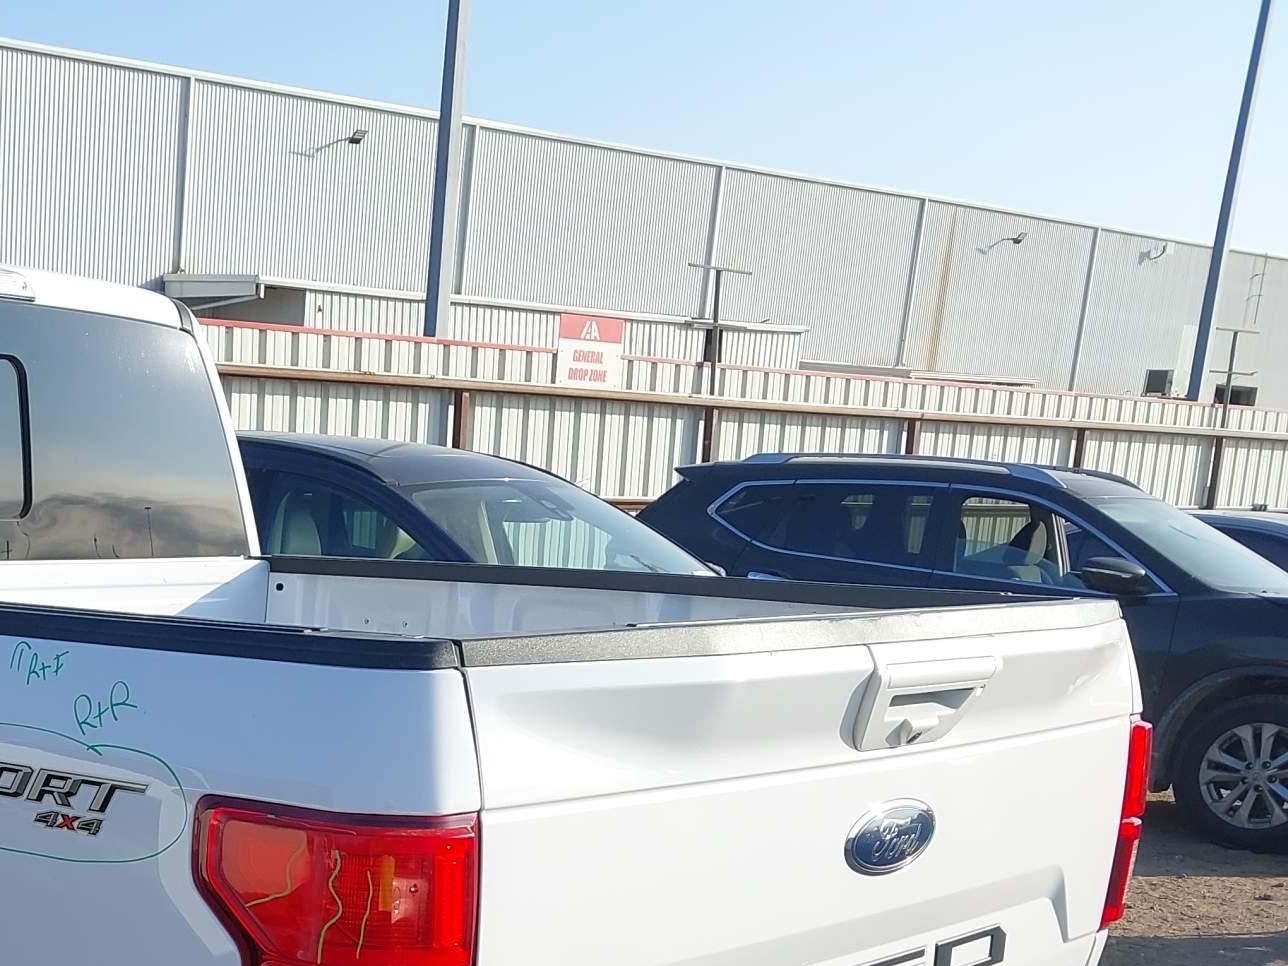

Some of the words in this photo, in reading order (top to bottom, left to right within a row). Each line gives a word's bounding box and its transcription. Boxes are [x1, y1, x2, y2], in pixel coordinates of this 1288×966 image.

[573, 349, 603, 364] GENERAL
[567, 367, 589, 381] DROP
[589, 369, 608, 383] ZONE
[872, 817, 923, 862] Ford
